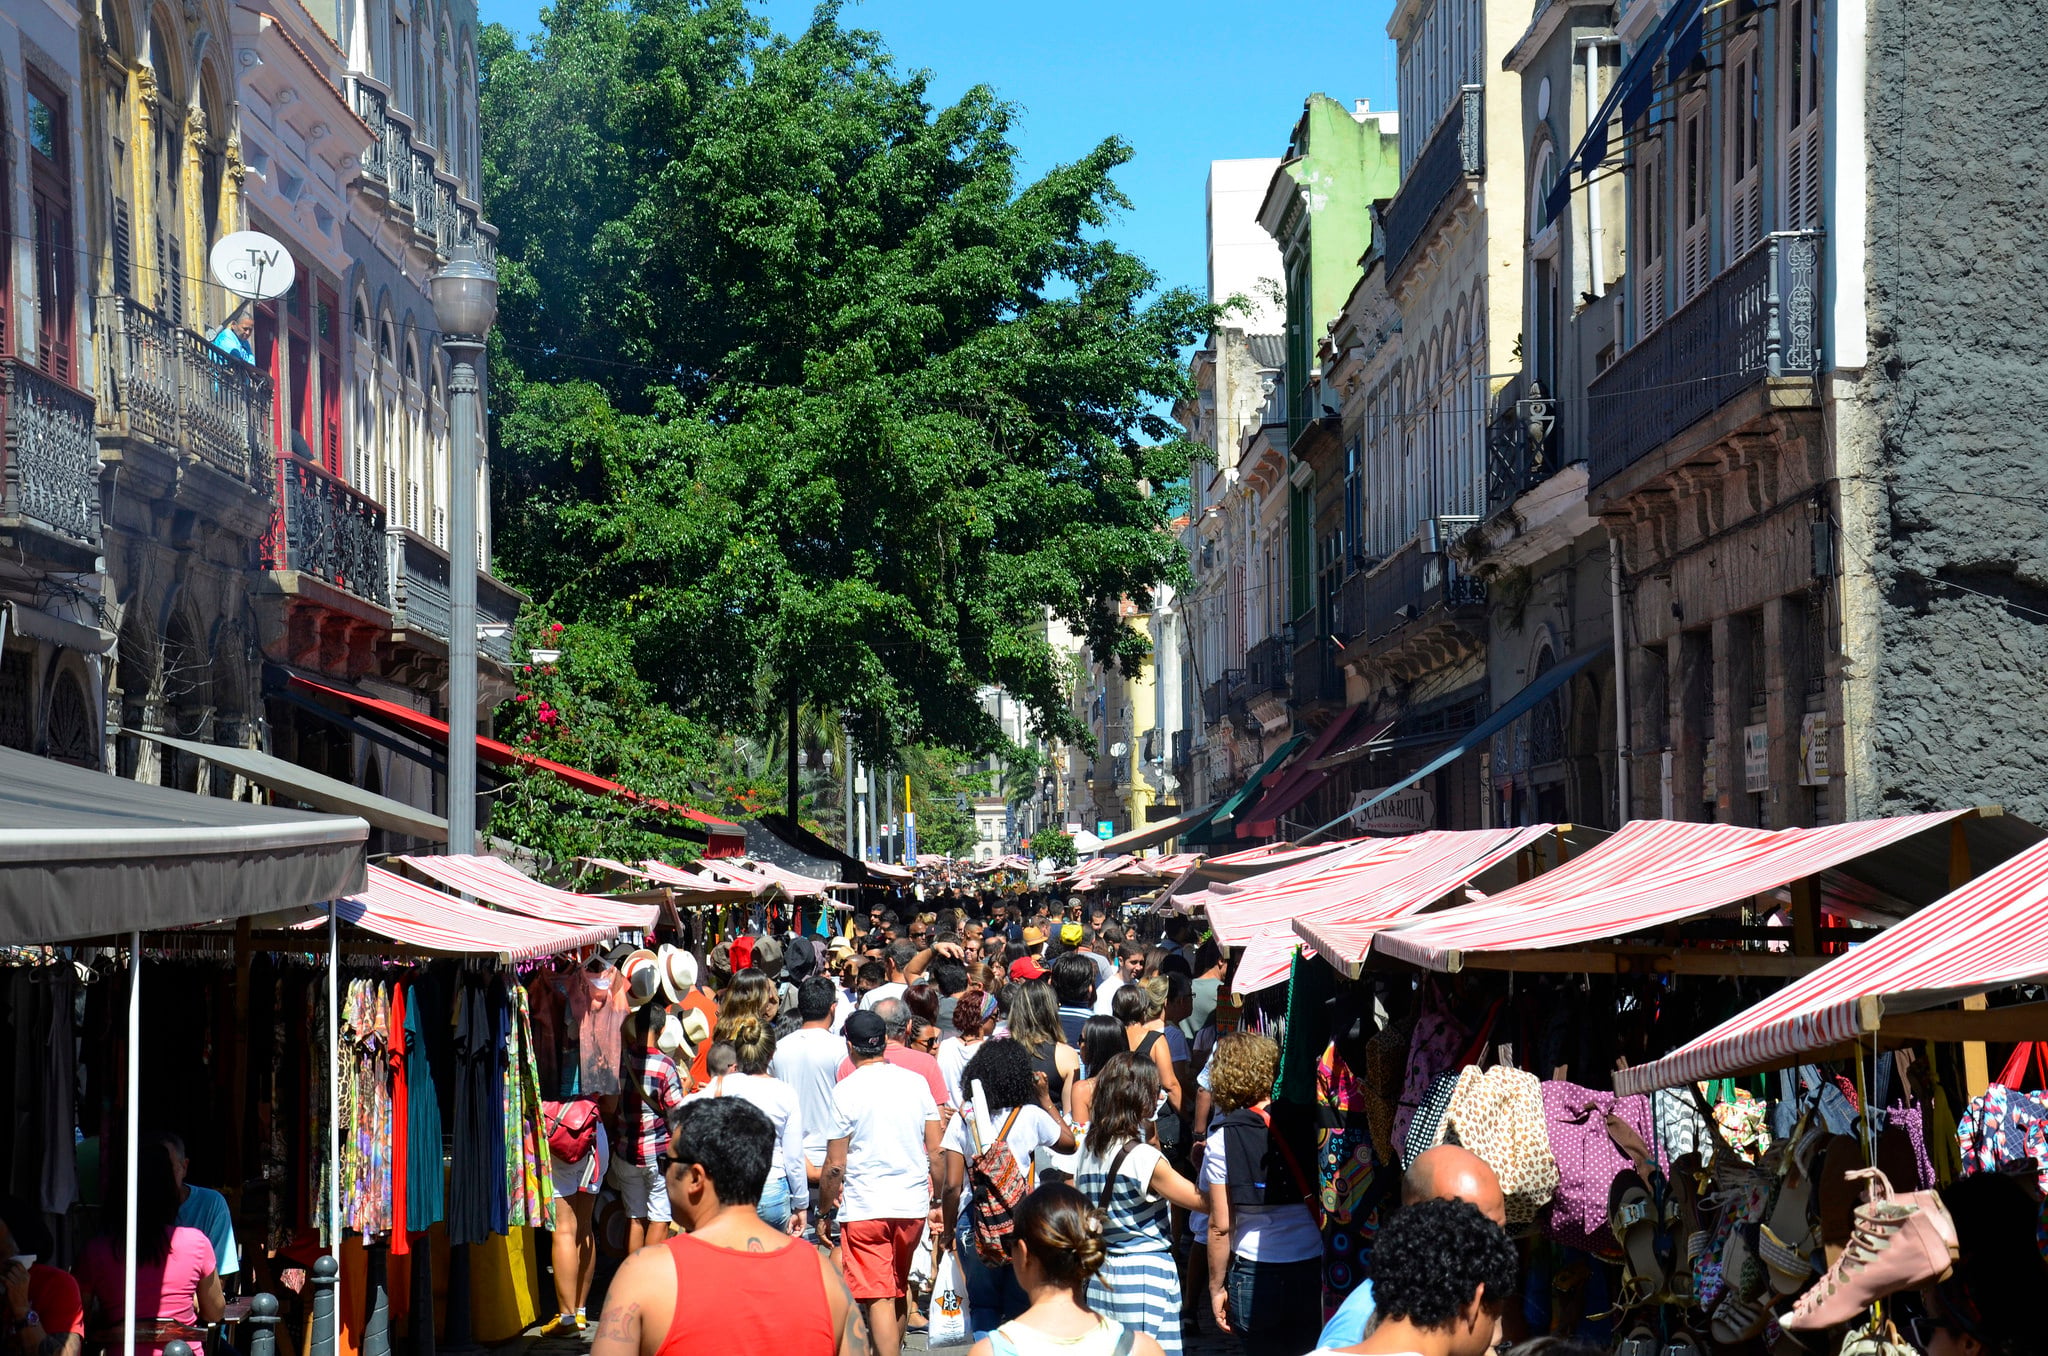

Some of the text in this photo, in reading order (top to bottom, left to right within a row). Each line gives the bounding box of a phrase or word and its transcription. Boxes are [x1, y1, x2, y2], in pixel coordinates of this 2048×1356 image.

[245, 248, 279, 267] TV
[234, 270, 247, 280] oi
[1360, 796, 1424, 822] SCENARIUM
